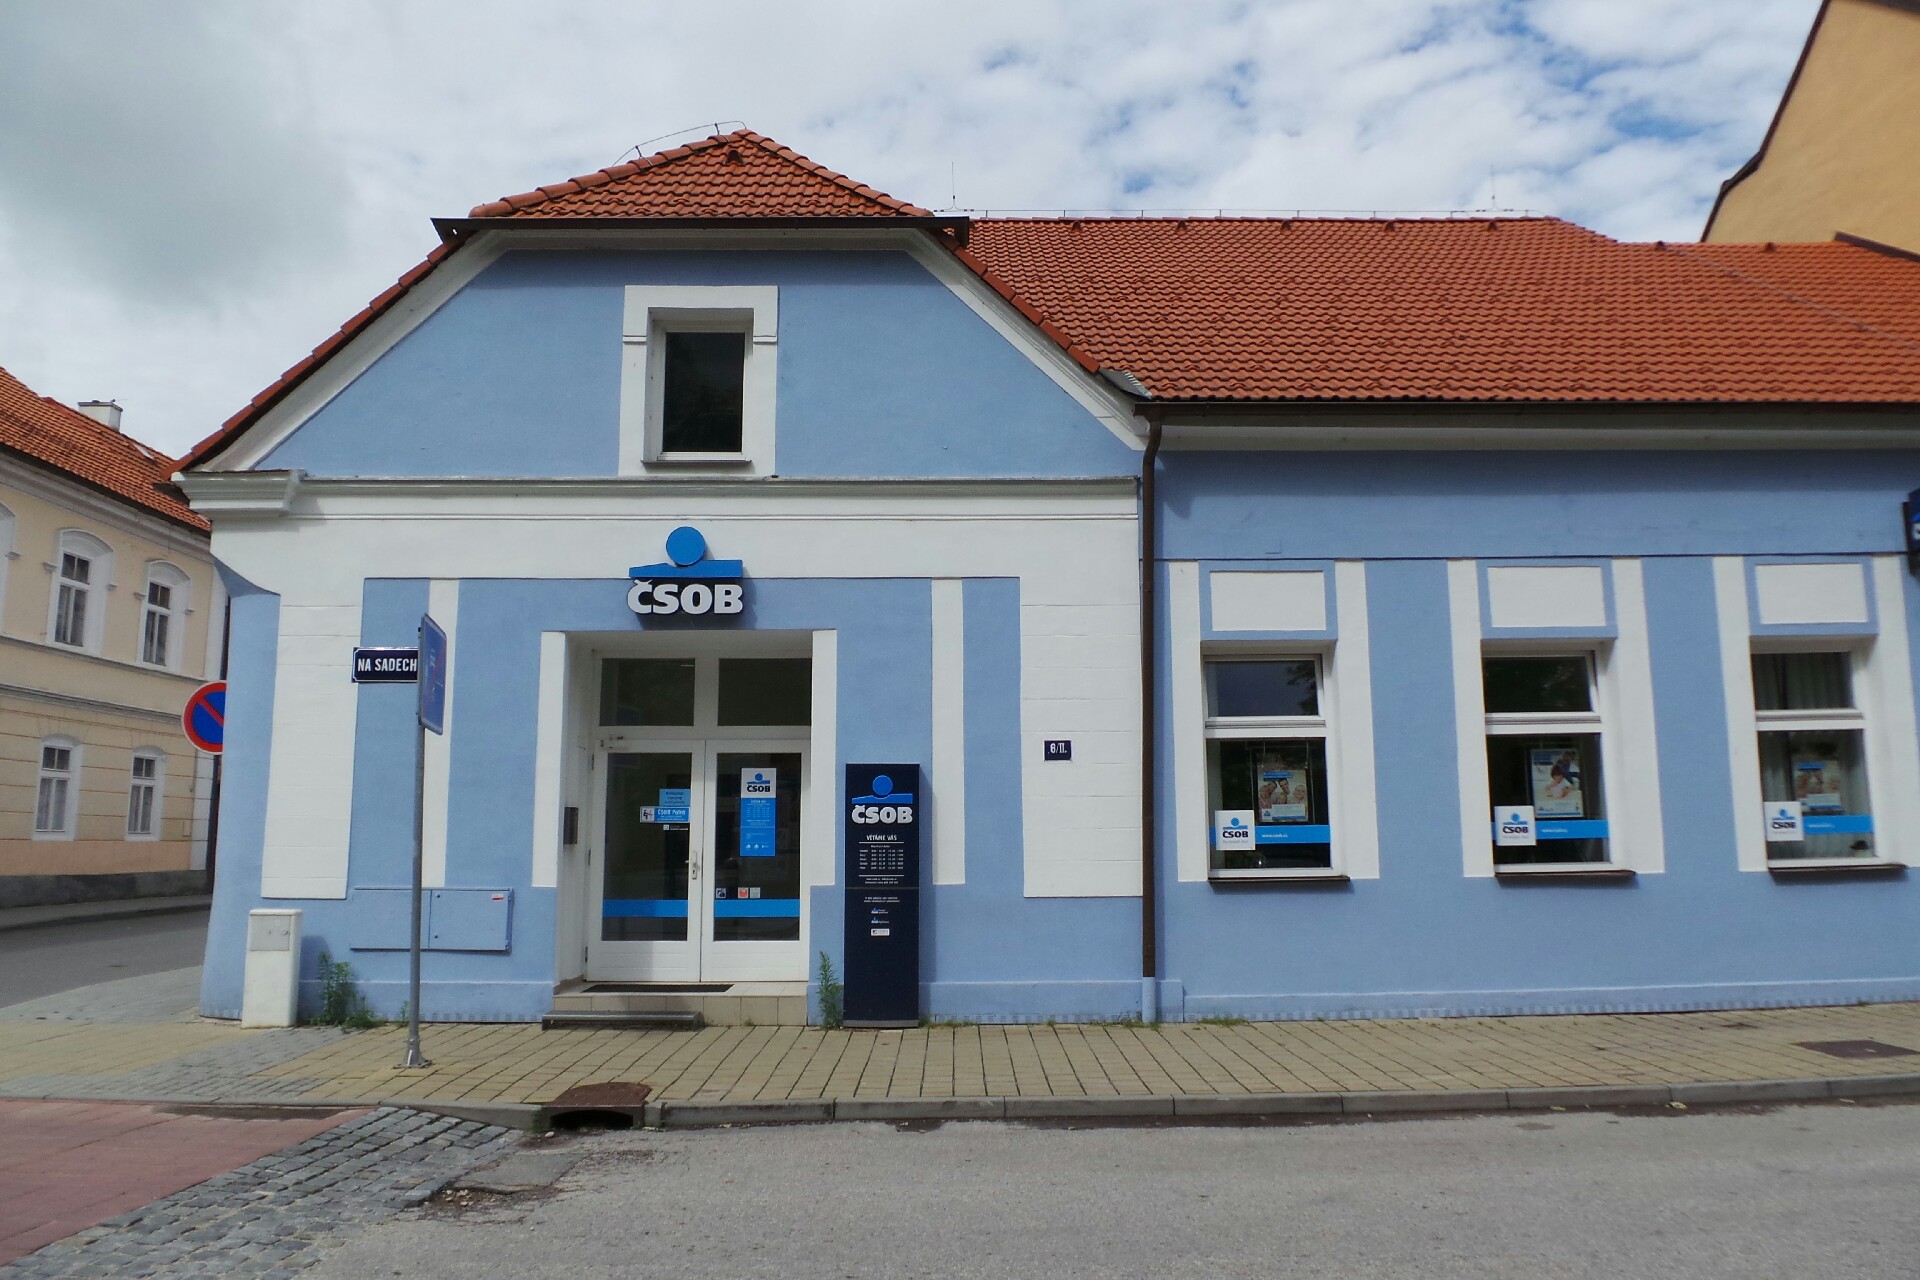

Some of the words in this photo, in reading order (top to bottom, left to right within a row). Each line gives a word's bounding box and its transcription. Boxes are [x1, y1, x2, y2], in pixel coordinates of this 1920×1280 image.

[627, 579, 743, 614] ČSOB
[357, 658, 371, 672] NA
[374, 658, 418, 672] SADECH
[746, 785, 771, 793] ČSOB
[851, 804, 913, 824] ČSOB
[1222, 829, 1249, 839] ČSOB
[1502, 825, 1529, 834] ČSOB
